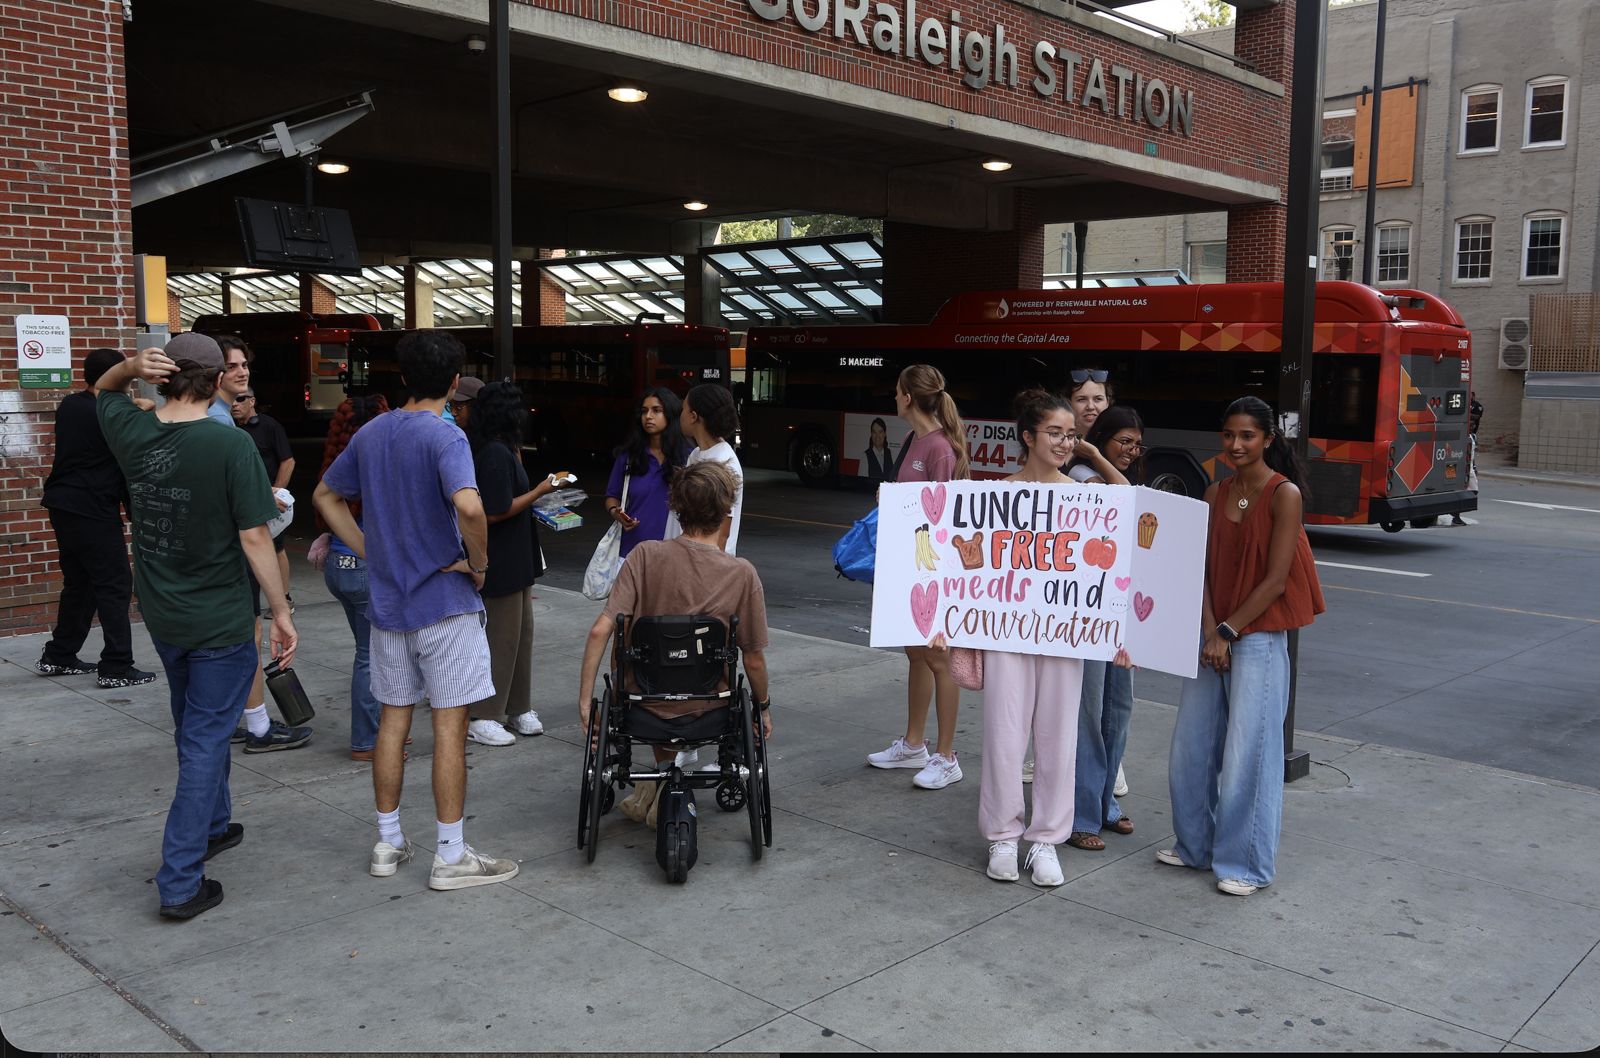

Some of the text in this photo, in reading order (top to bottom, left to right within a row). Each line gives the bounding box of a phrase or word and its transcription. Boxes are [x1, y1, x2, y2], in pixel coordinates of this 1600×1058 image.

[1032, 40, 1194, 137] STATION
[1013, 300, 1045, 308] POWERED
[1132, 298, 1147, 306] GAS
[1053, 309, 1071, 317] Raleigh
[954, 333, 1070, 345] Connecting the Capital Area
[1436, 448, 1446, 460] GO
[171, 487, 191, 501] 828
[953, 489, 1118, 533] LUNCH with love
[991, 530, 1080, 572] FREE
[943, 570, 1106, 610] meals and
